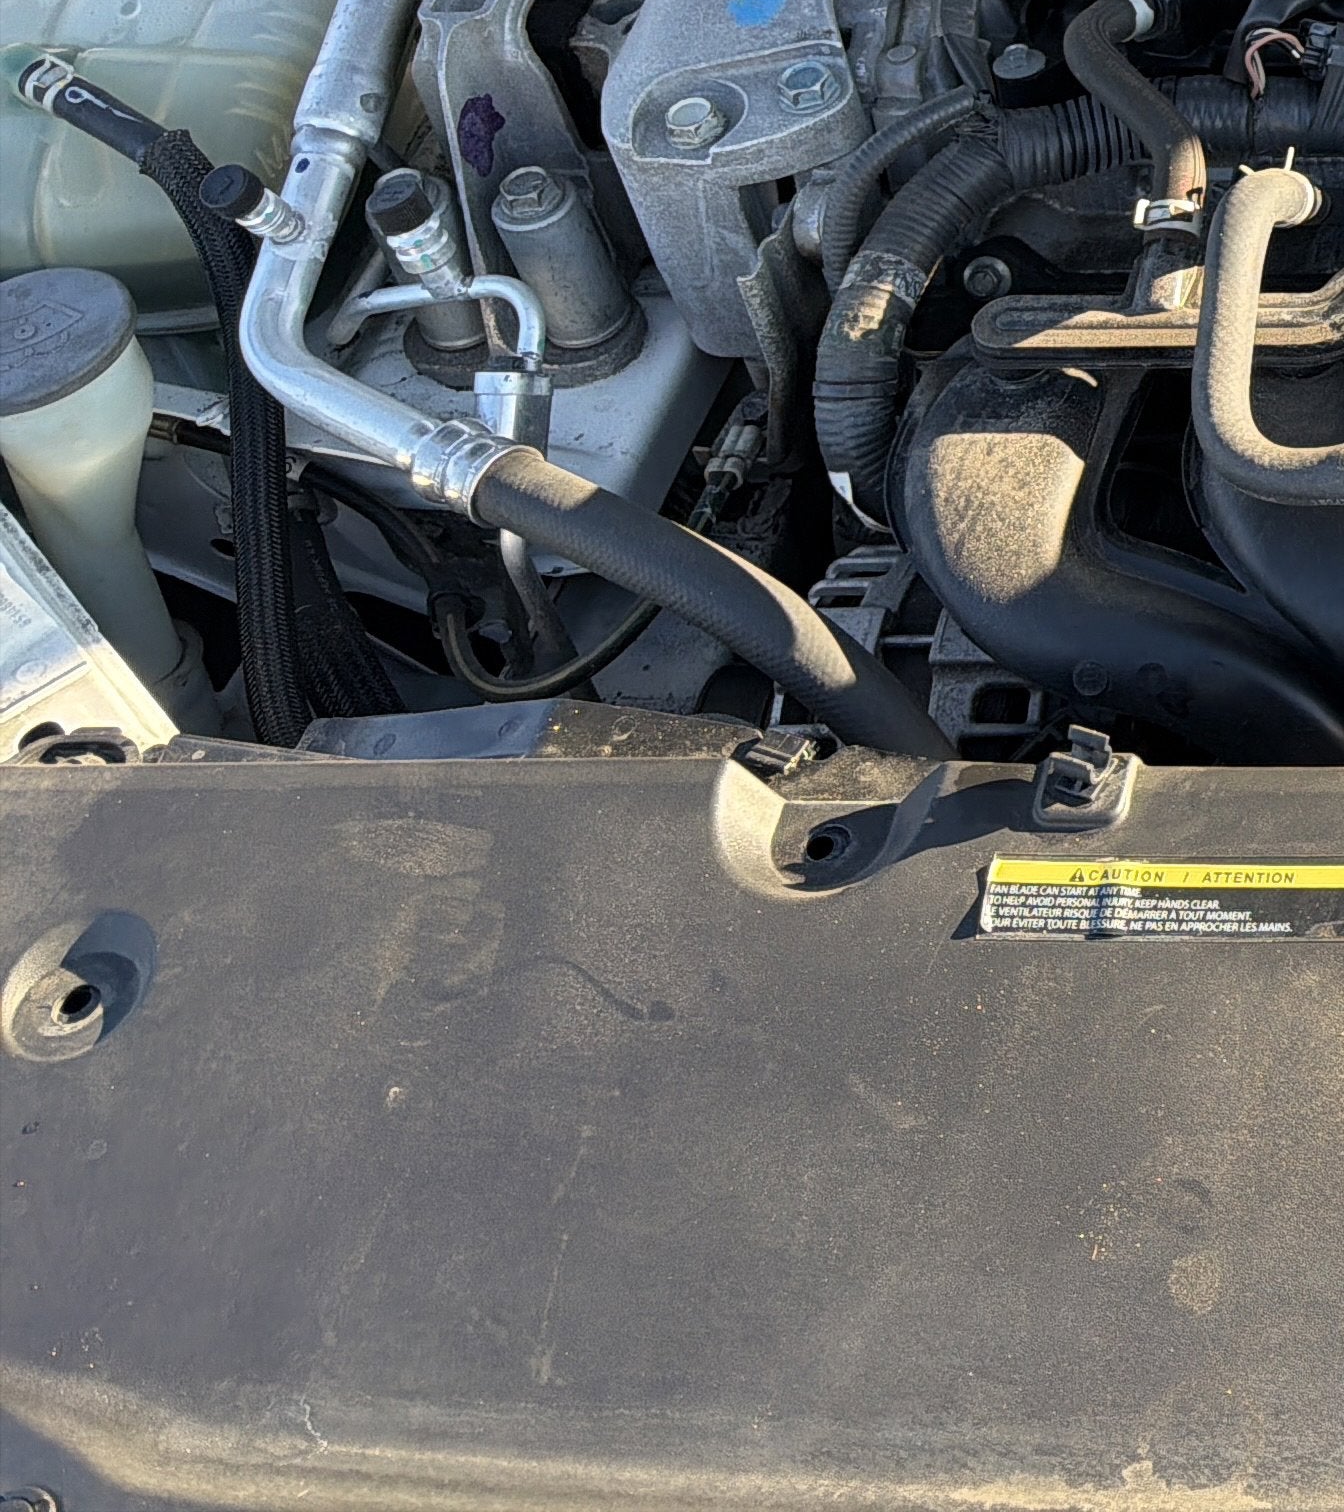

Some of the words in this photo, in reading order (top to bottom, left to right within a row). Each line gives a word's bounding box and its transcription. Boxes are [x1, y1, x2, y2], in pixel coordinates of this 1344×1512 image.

[1088, 869, 1165, 883] CAUTION
[1202, 871, 1296, 884] ATTENTION
[989, 884, 1008, 894] FAN
[1009, 885, 1038, 895] BLADE
[1039, 886, 1059, 896] CAN
[1060, 886, 1087, 896] START
[1088, 886, 1100, 896] AT
[1100, 886, 1118, 896] ANY
[1119, 886, 1142, 897] TIME.
[989, 895, 1001, 905] TO
[1002, 896, 1026, 906] HELP
[1026, 896, 1054, 906] AVOID
[1055, 897, 1100, 907] PERSONAL
[1102, 897, 1133, 908] INJURY,
[1134, 899, 1157, 909] KEEP
[1158, 899, 1190, 909] HANDS
[997, 906, 1062, 917] VENTILATEUR
[1063, 908, 1098, 919] RISQUE
[1099, 908, 1113, 918] DE
[1114, 907, 1168, 920] DÉMARRER
[1178, 910, 1204, 920] TOUT
[1205, 911, 1253, 921] MOMENT.
[1047, 918, 1078, 929] TOUTE
[1129, 920, 1143, 930] NE
[1144, 920, 1164, 931] PAS
[1164, 921, 1179, 931] EN
[1179, 921, 1239, 933] APPROCHER
[1240, 922, 1258, 932] LES
[1258, 922, 1293, 933] MAINS.
